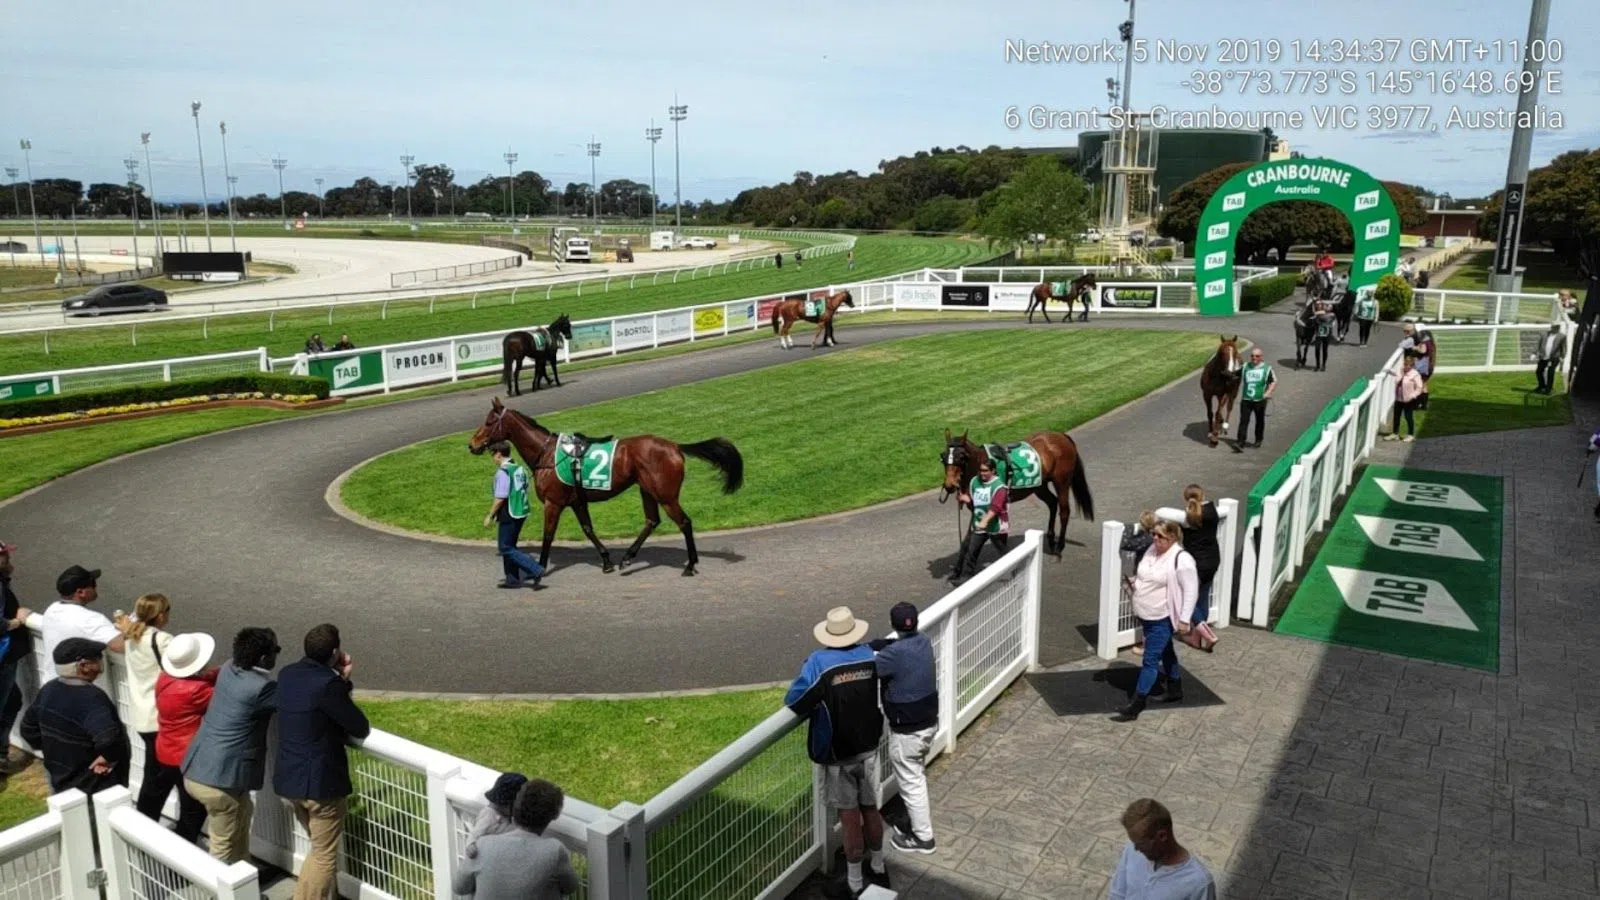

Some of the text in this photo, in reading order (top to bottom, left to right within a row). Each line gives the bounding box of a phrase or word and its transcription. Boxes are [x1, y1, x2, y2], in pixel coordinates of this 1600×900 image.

[1246, 164, 1352, 188] CRANBOURNE
[1274, 184, 1321, 195] Australia
[1226, 197, 1243, 206] TAB
[1357, 196, 1377, 205] TAB
[1210, 227, 1227, 236] TAB
[1368, 225, 1388, 235] TAB
[1207, 256, 1224, 265] TAB
[1367, 257, 1387, 267] TAB
[1207, 284, 1224, 293] TAB
[395, 351, 444, 370] PROCON
[335, 363, 359, 380] TAB
[1246, 383, 1257, 397] 5
[588, 449, 610, 481] 2
[1017, 448, 1040, 478] 3
[1405, 483, 1451, 504] TAB
[1389, 522, 1441, 549] TAB
[1365, 577, 1429, 615] TAB
